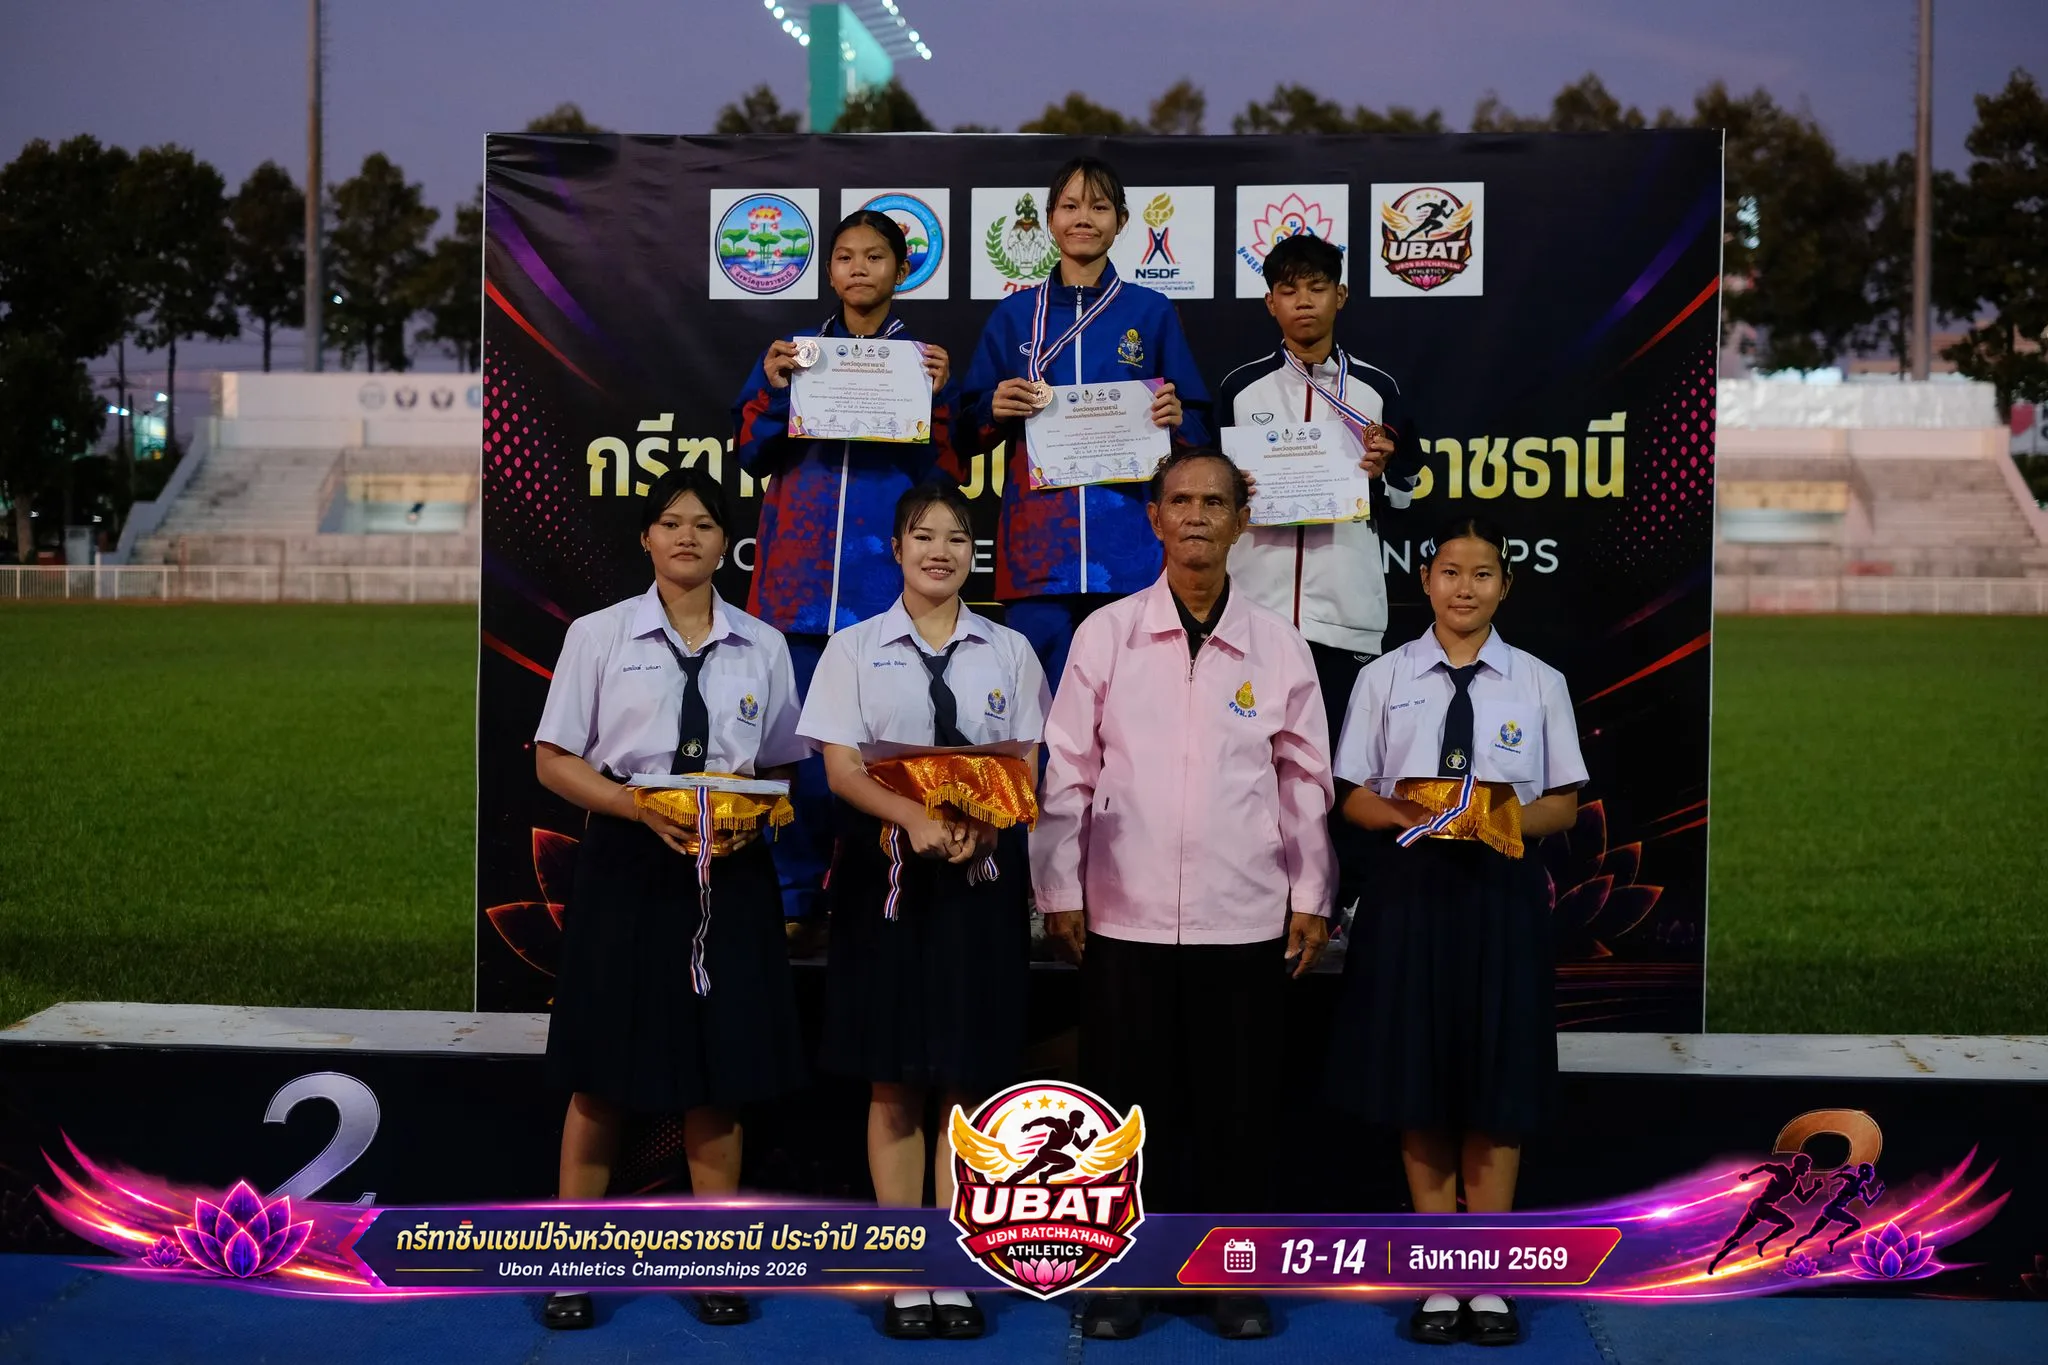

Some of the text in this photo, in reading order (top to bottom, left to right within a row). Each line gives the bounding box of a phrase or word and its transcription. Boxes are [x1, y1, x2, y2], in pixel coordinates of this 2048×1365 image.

[1388, 240, 1466, 261] UBAT
[1135, 268, 1180, 279] NSDF
[262, 1071, 381, 1206] 2
